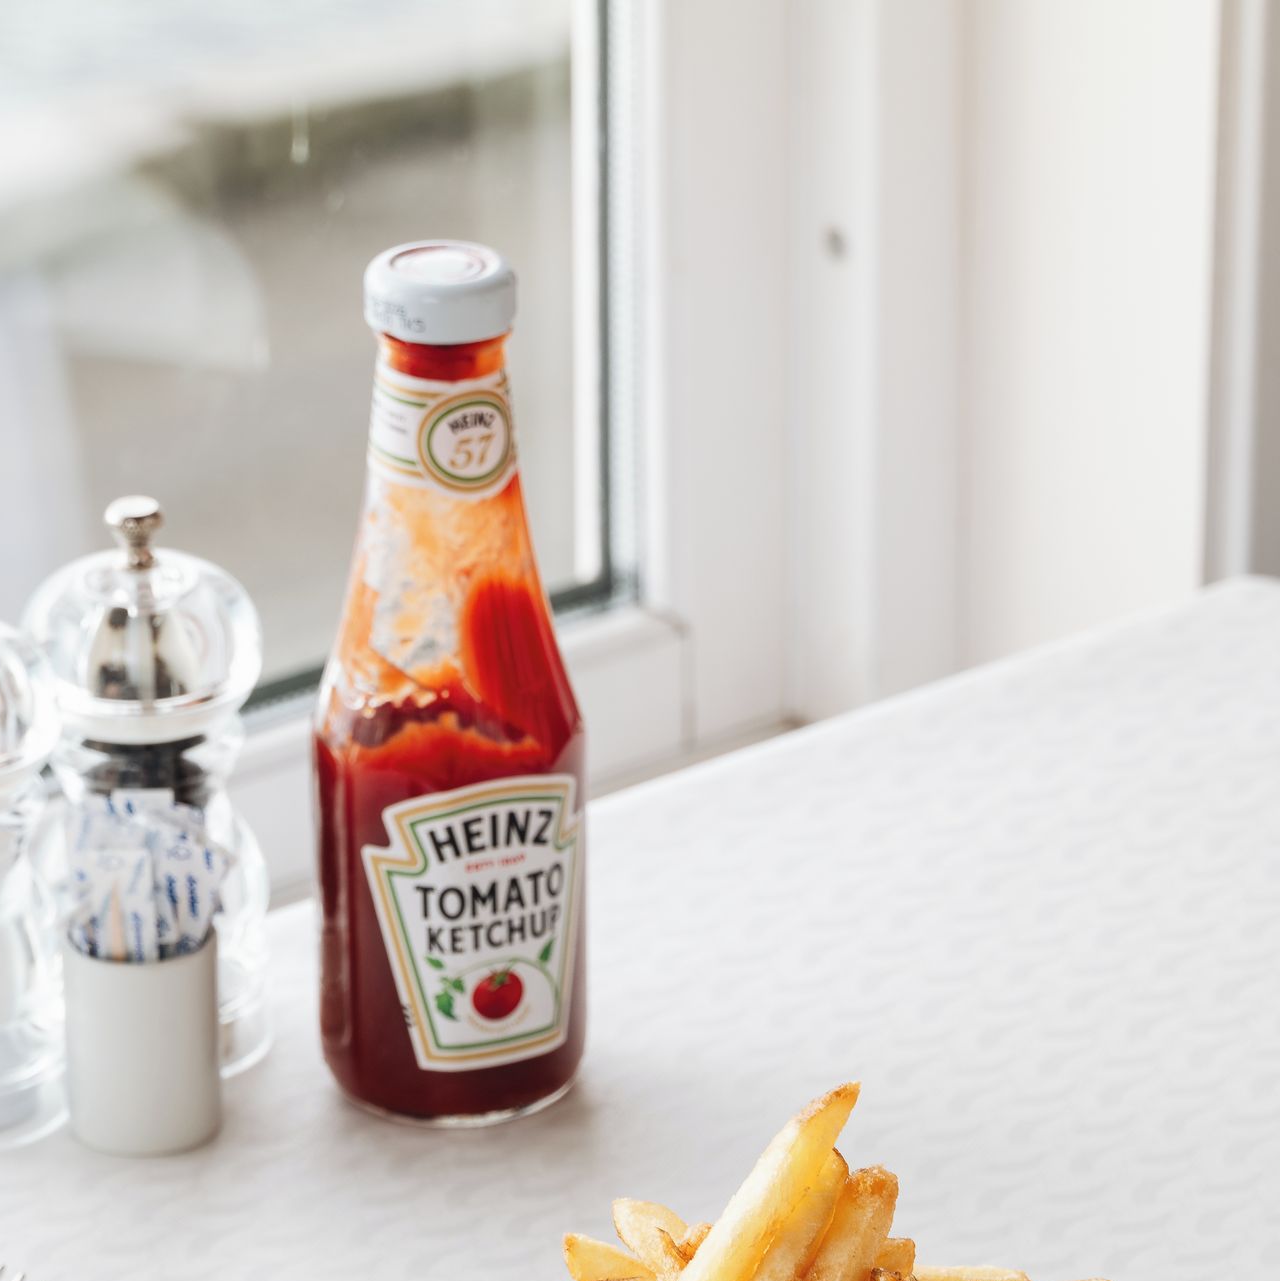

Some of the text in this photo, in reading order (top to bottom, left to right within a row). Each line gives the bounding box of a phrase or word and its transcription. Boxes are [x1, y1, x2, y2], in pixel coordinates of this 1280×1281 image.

[449, 412, 495, 434] HEINZ
[449, 434, 495, 469] 57
[429, 809, 555, 863] HEINZ
[415, 863, 564, 920] TOMATO
[427, 904, 561, 954] KETCHUP
